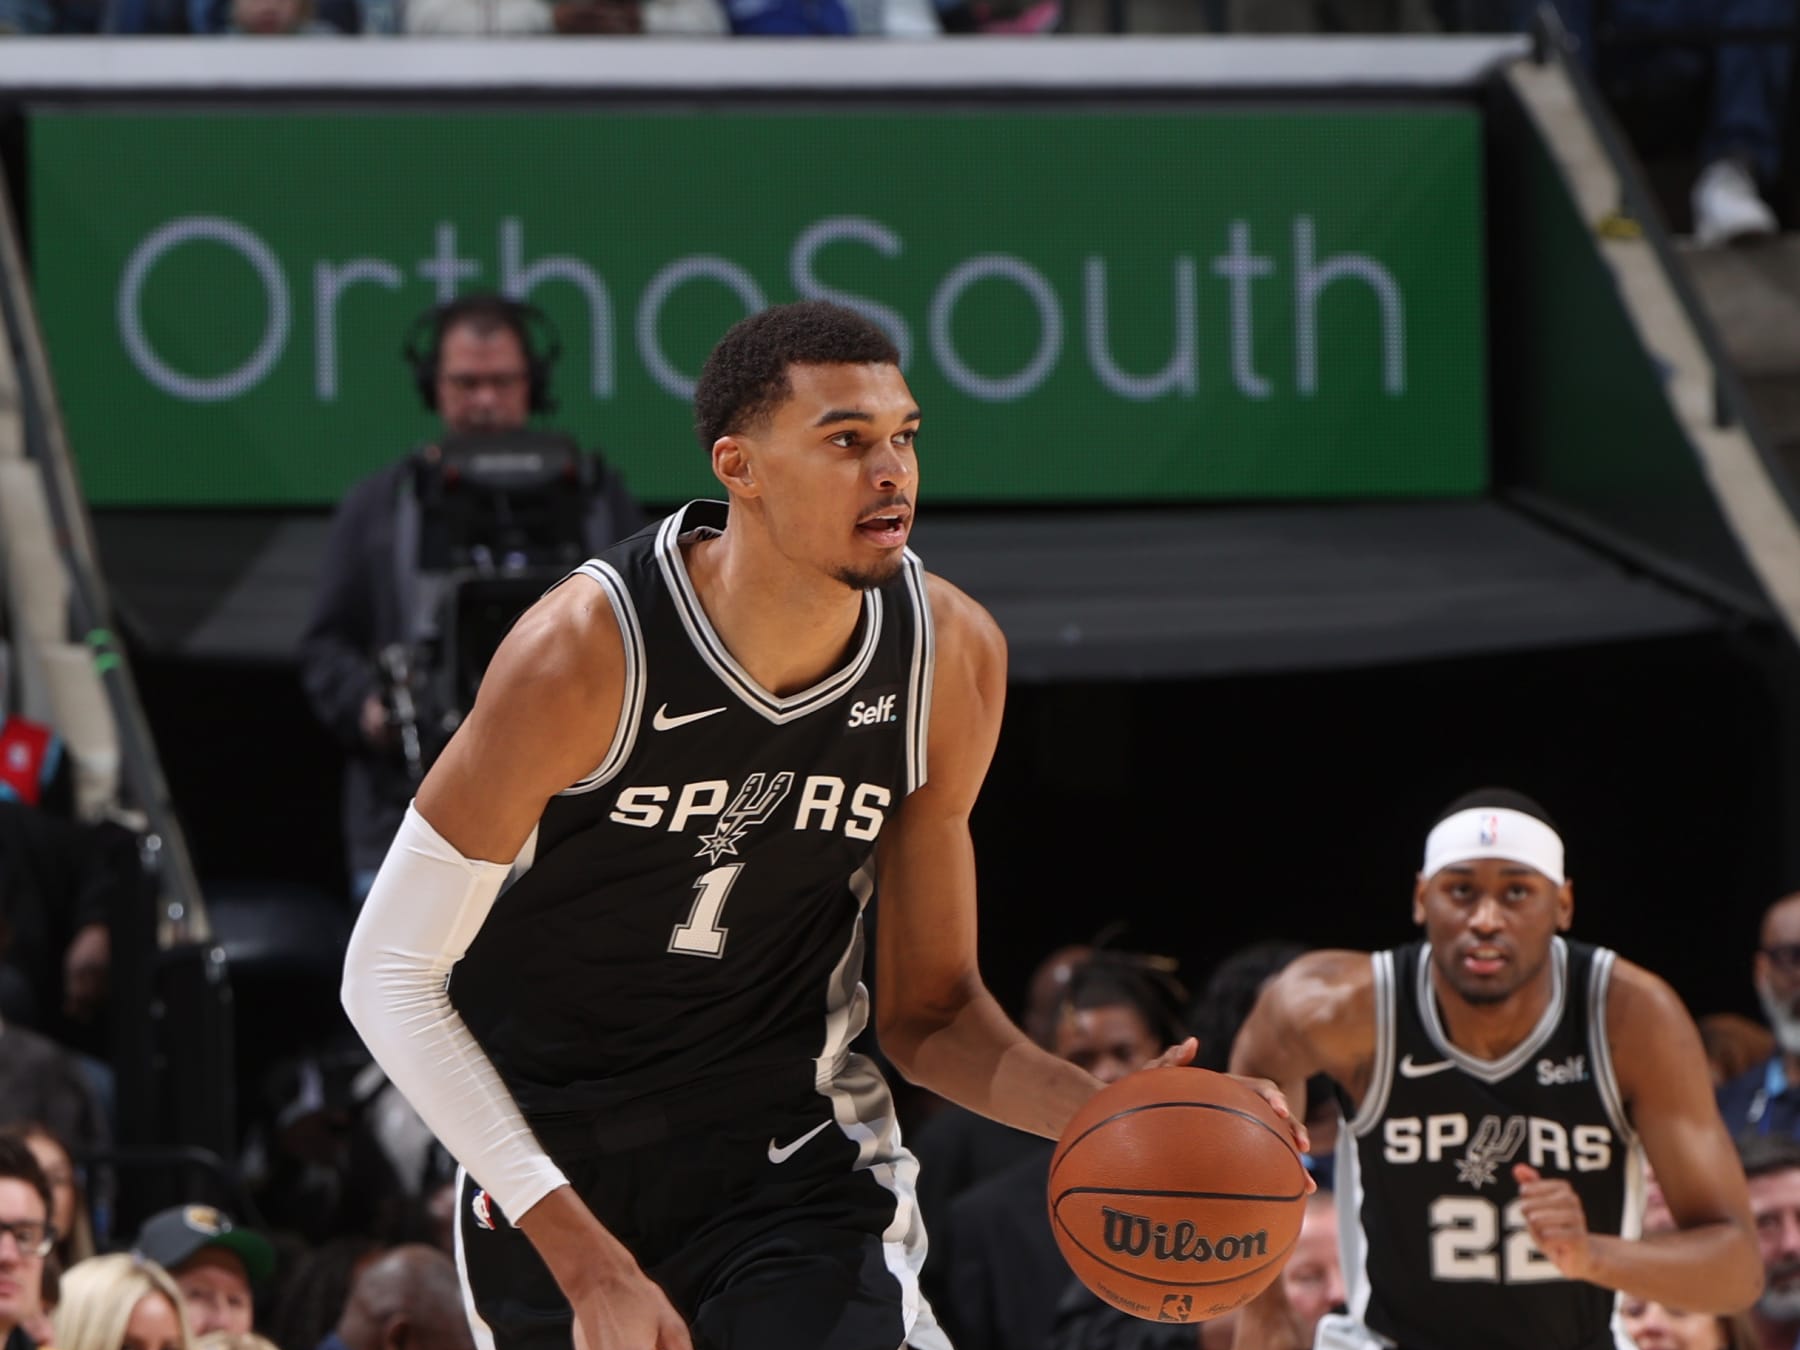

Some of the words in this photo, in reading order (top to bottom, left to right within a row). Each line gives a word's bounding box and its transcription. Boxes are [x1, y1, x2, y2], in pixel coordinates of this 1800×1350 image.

[848, 694, 897, 727] Self.
[609, 772, 891, 865] SPURS
[667, 862, 746, 959] 1
[1383, 1113, 1612, 1190] SPURS
[1101, 1206, 1269, 1263] Wilson
[1428, 1195, 1568, 1286] 22
